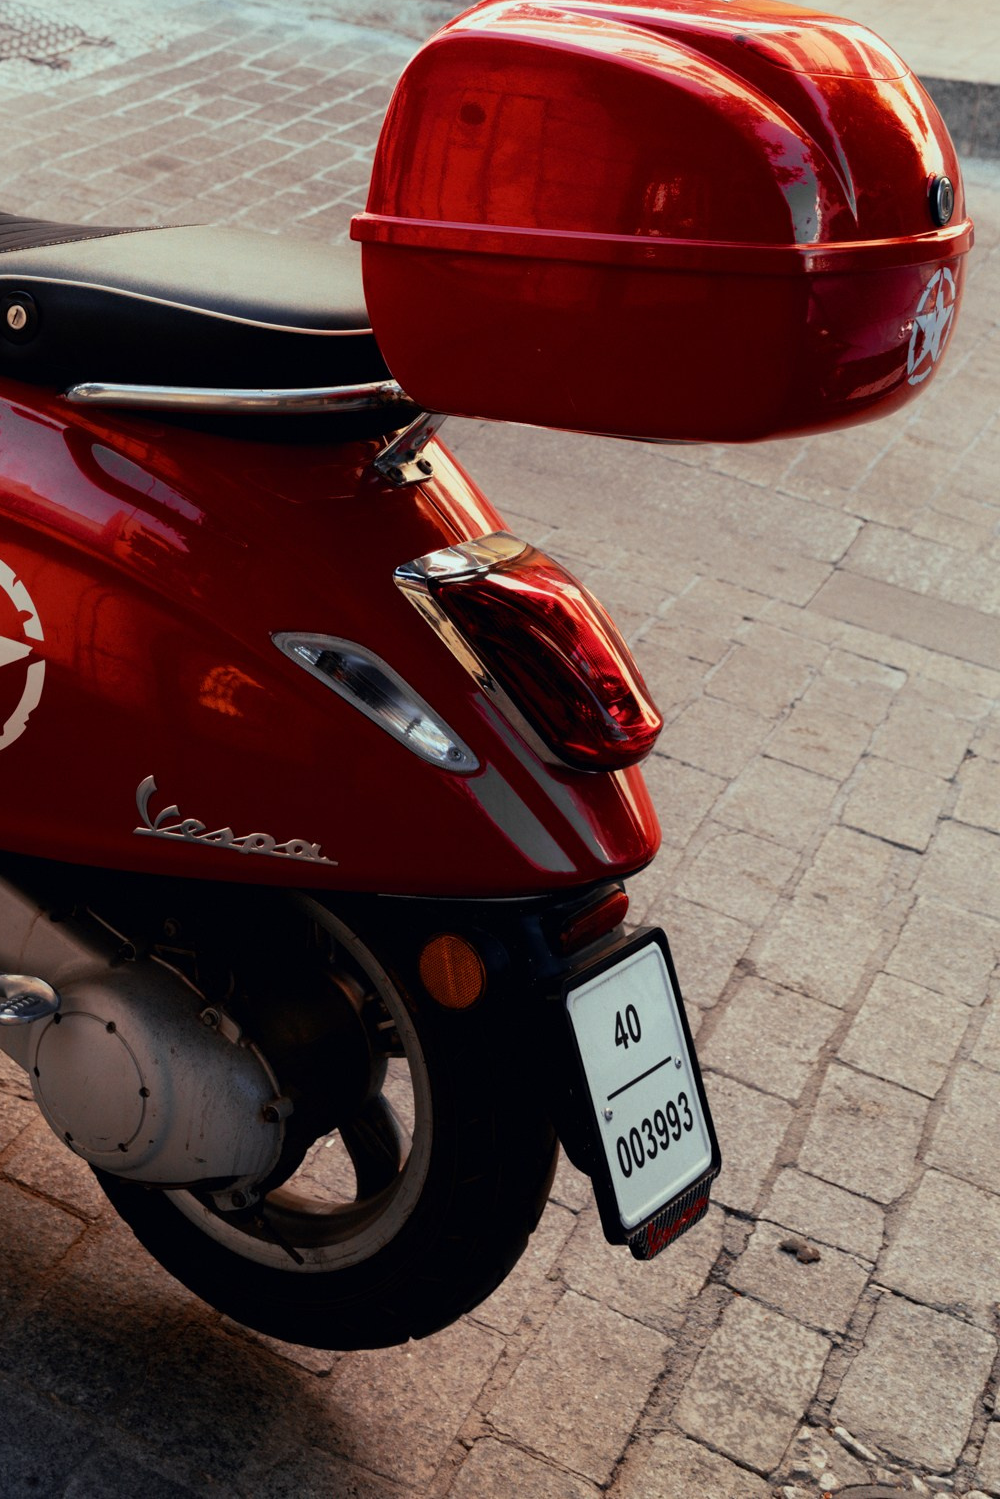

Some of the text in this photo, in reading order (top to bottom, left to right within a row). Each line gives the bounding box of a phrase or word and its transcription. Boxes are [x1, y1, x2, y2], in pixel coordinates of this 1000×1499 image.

[133, 775, 339, 866] Vespa
[614, 1003, 642, 1049] 40
[616, 1091, 694, 1178] 003993
